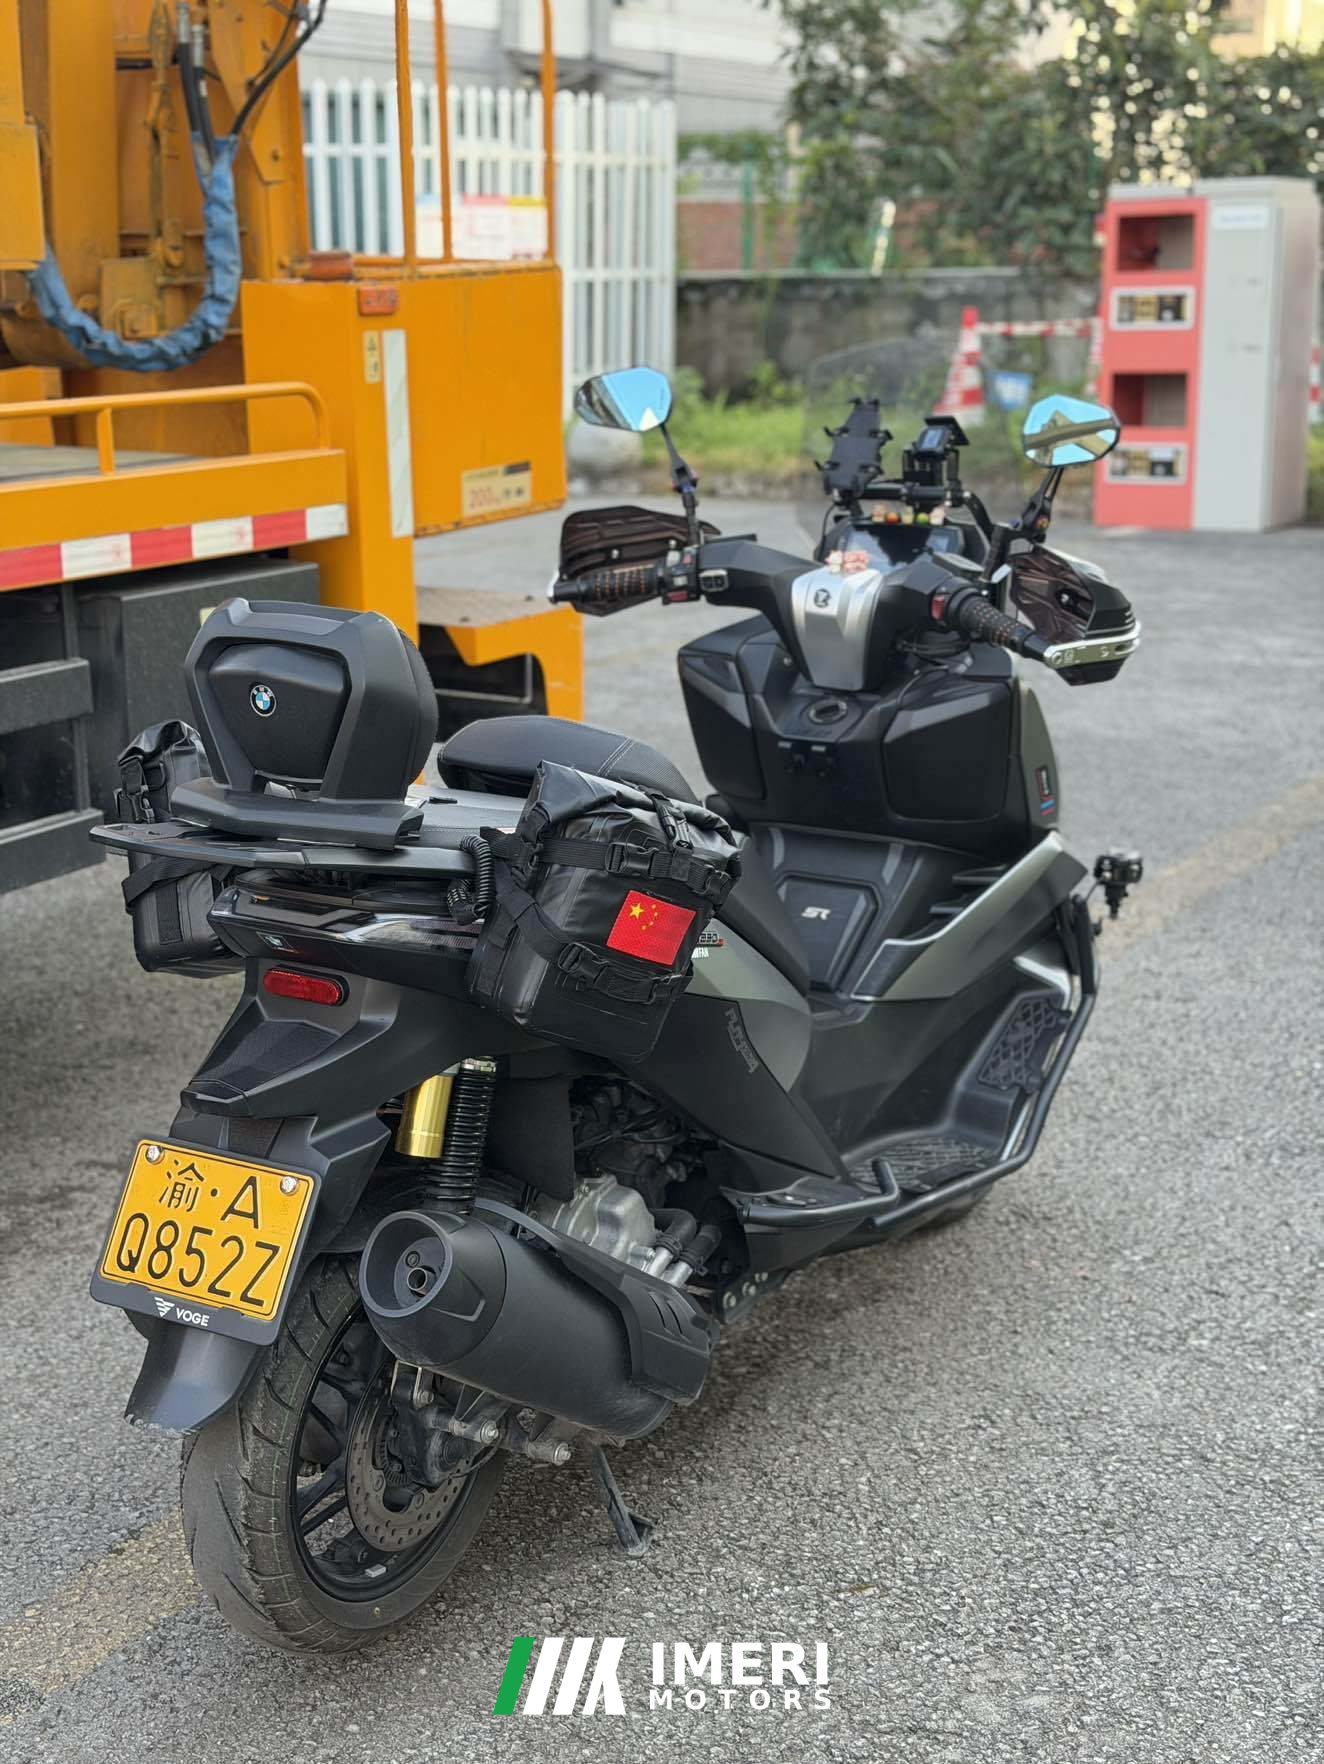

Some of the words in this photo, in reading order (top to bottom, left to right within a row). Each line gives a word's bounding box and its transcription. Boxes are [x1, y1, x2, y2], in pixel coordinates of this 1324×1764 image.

[801, 906, 831, 920] SR
[116, 1212, 281, 1307] Q852Z
[176, 1307, 210, 1327] VOGE
